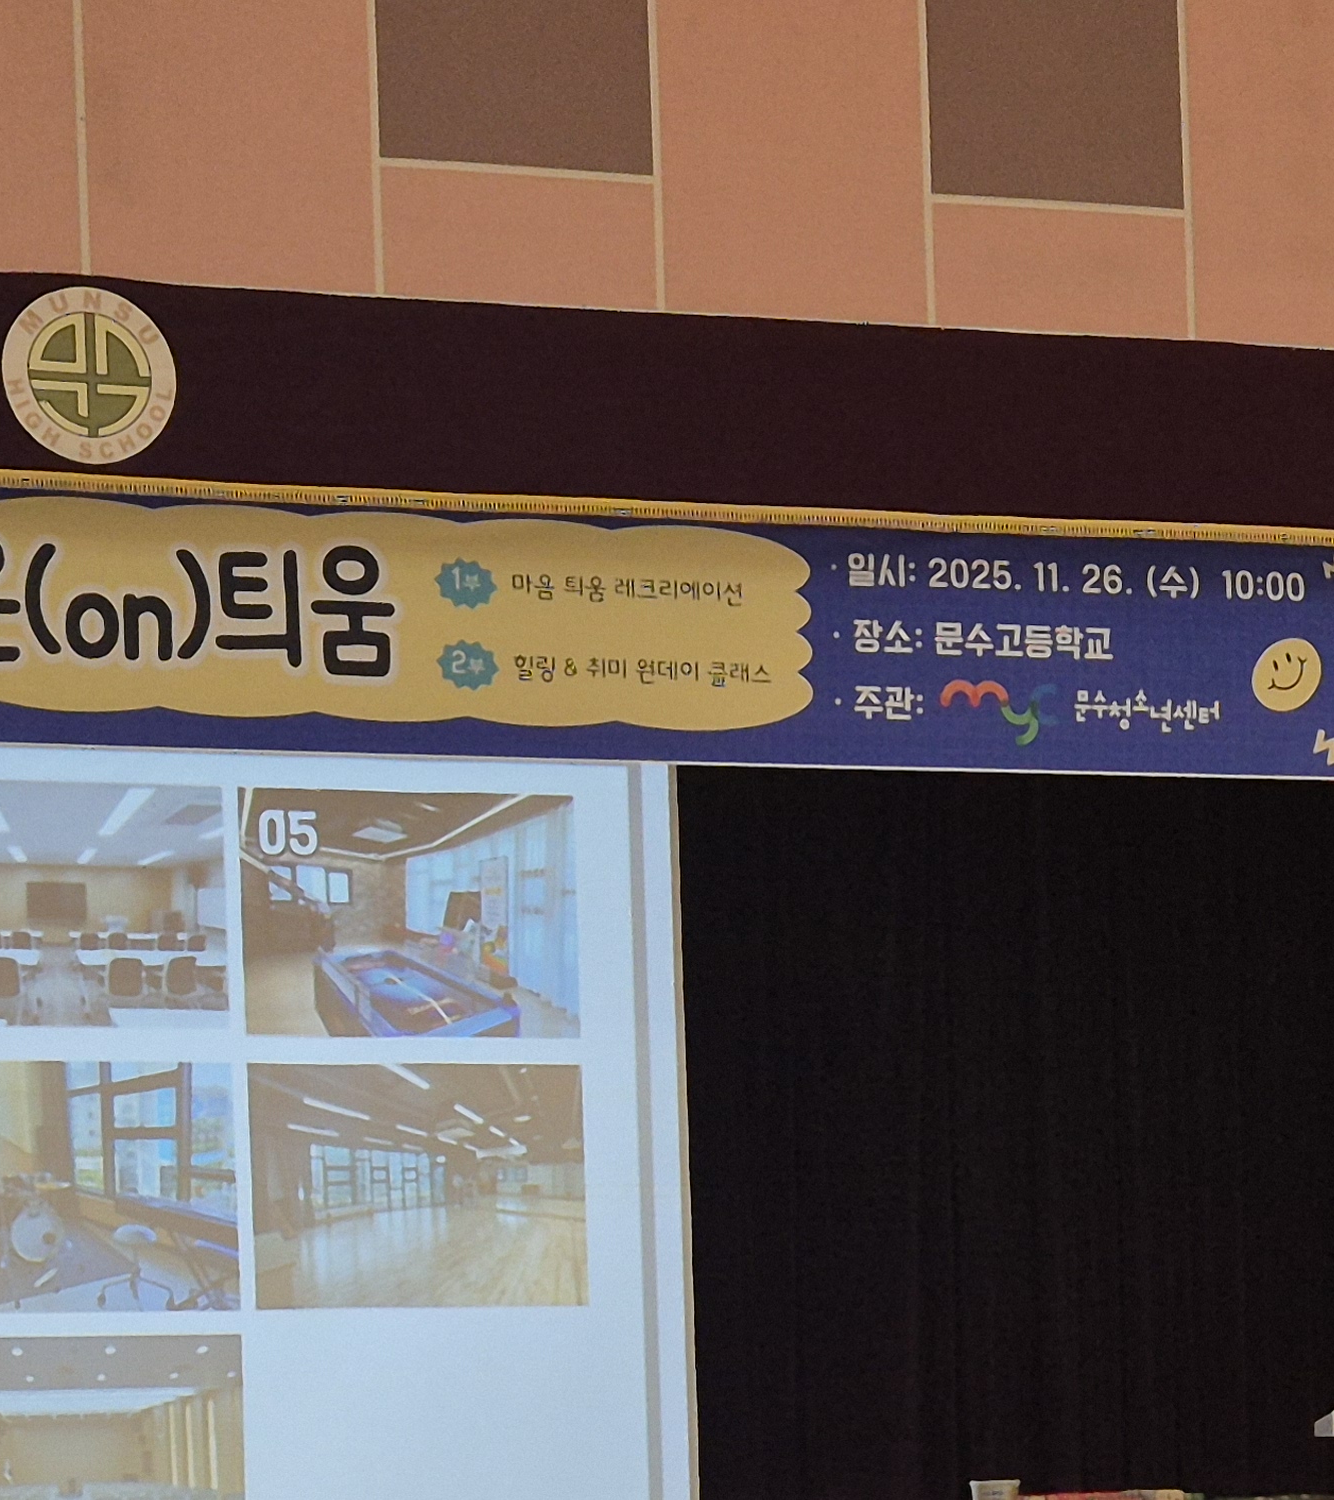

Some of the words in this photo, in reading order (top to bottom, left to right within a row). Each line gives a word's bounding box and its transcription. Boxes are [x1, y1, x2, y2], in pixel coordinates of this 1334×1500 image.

[19, 291, 159, 345] MUNSU
[7, 378, 61, 447] HIGH
[79, 390, 173, 459] SCHOOL
[512, 574, 555, 600] 마음
[564, 575, 606, 602] 틔움
[615, 578, 742, 606] 레크리에이션
[847, 553, 916, 588] 일시:
[928, 558, 1022, 592] 2025.
[1033, 561, 1069, 593] 11.
[1081, 564, 1132, 595] 26.
[1146, 565, 1199, 599] (수)
[1222, 569, 1306, 602] 10:00
[853, 619, 923, 655] 장소:
[934, 622, 1113, 660] 문수고등학교
[514, 655, 556, 683] 힐링
[586, 657, 626, 678] 취미
[636, 659, 698, 684] 원데이
[708, 662, 772, 687] 클래스
[853, 686, 924, 720] 주관:
[1073, 689, 1221, 733] 문수청소년센터
[257, 809, 319, 857] 05
